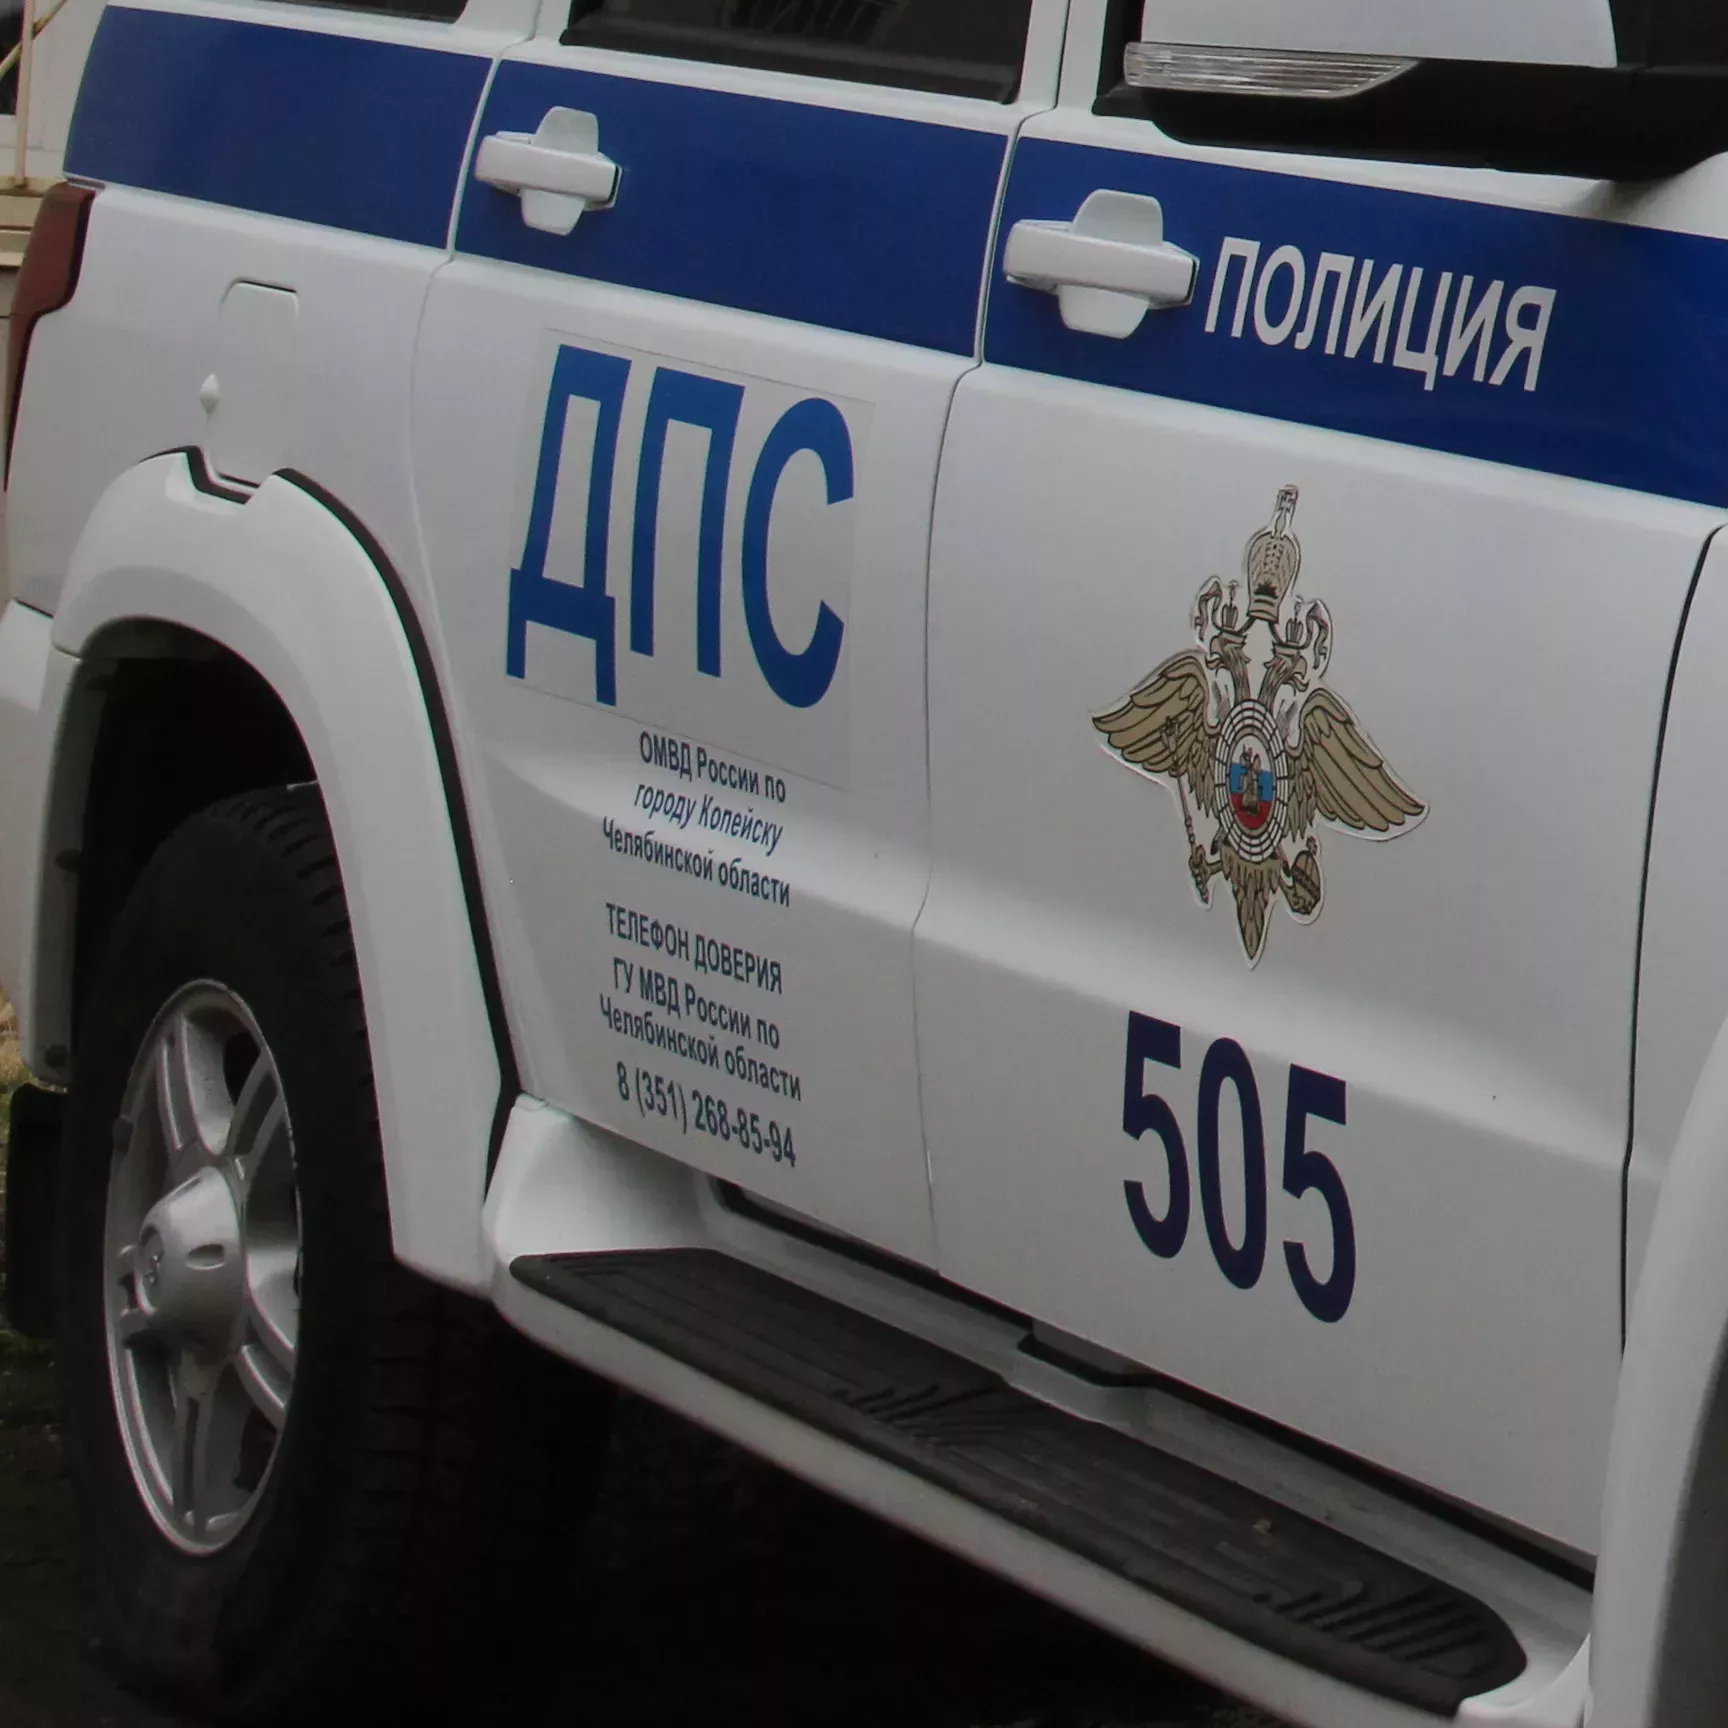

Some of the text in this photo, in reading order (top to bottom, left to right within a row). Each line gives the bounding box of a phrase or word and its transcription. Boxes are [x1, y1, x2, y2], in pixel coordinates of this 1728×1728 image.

[1204, 237, 1556, 391] ПОЛИЦИЯ
[506, 344, 853, 708] ДПС
[639, 730, 787, 803] ОМВД России по
[602, 815, 790, 907] Челябинской области
[634, 783, 783, 856] городу Копейску
[606, 902, 782, 995] ТЕЛЕФОН ДОВЕРИЯ
[600, 993, 802, 1102] Челябинской области
[613, 957, 780, 1049] ГУ МВД России по
[616, 1061, 796, 1167] 8 (351) 268-85-94
[1122, 1010, 1356, 1323] 505
